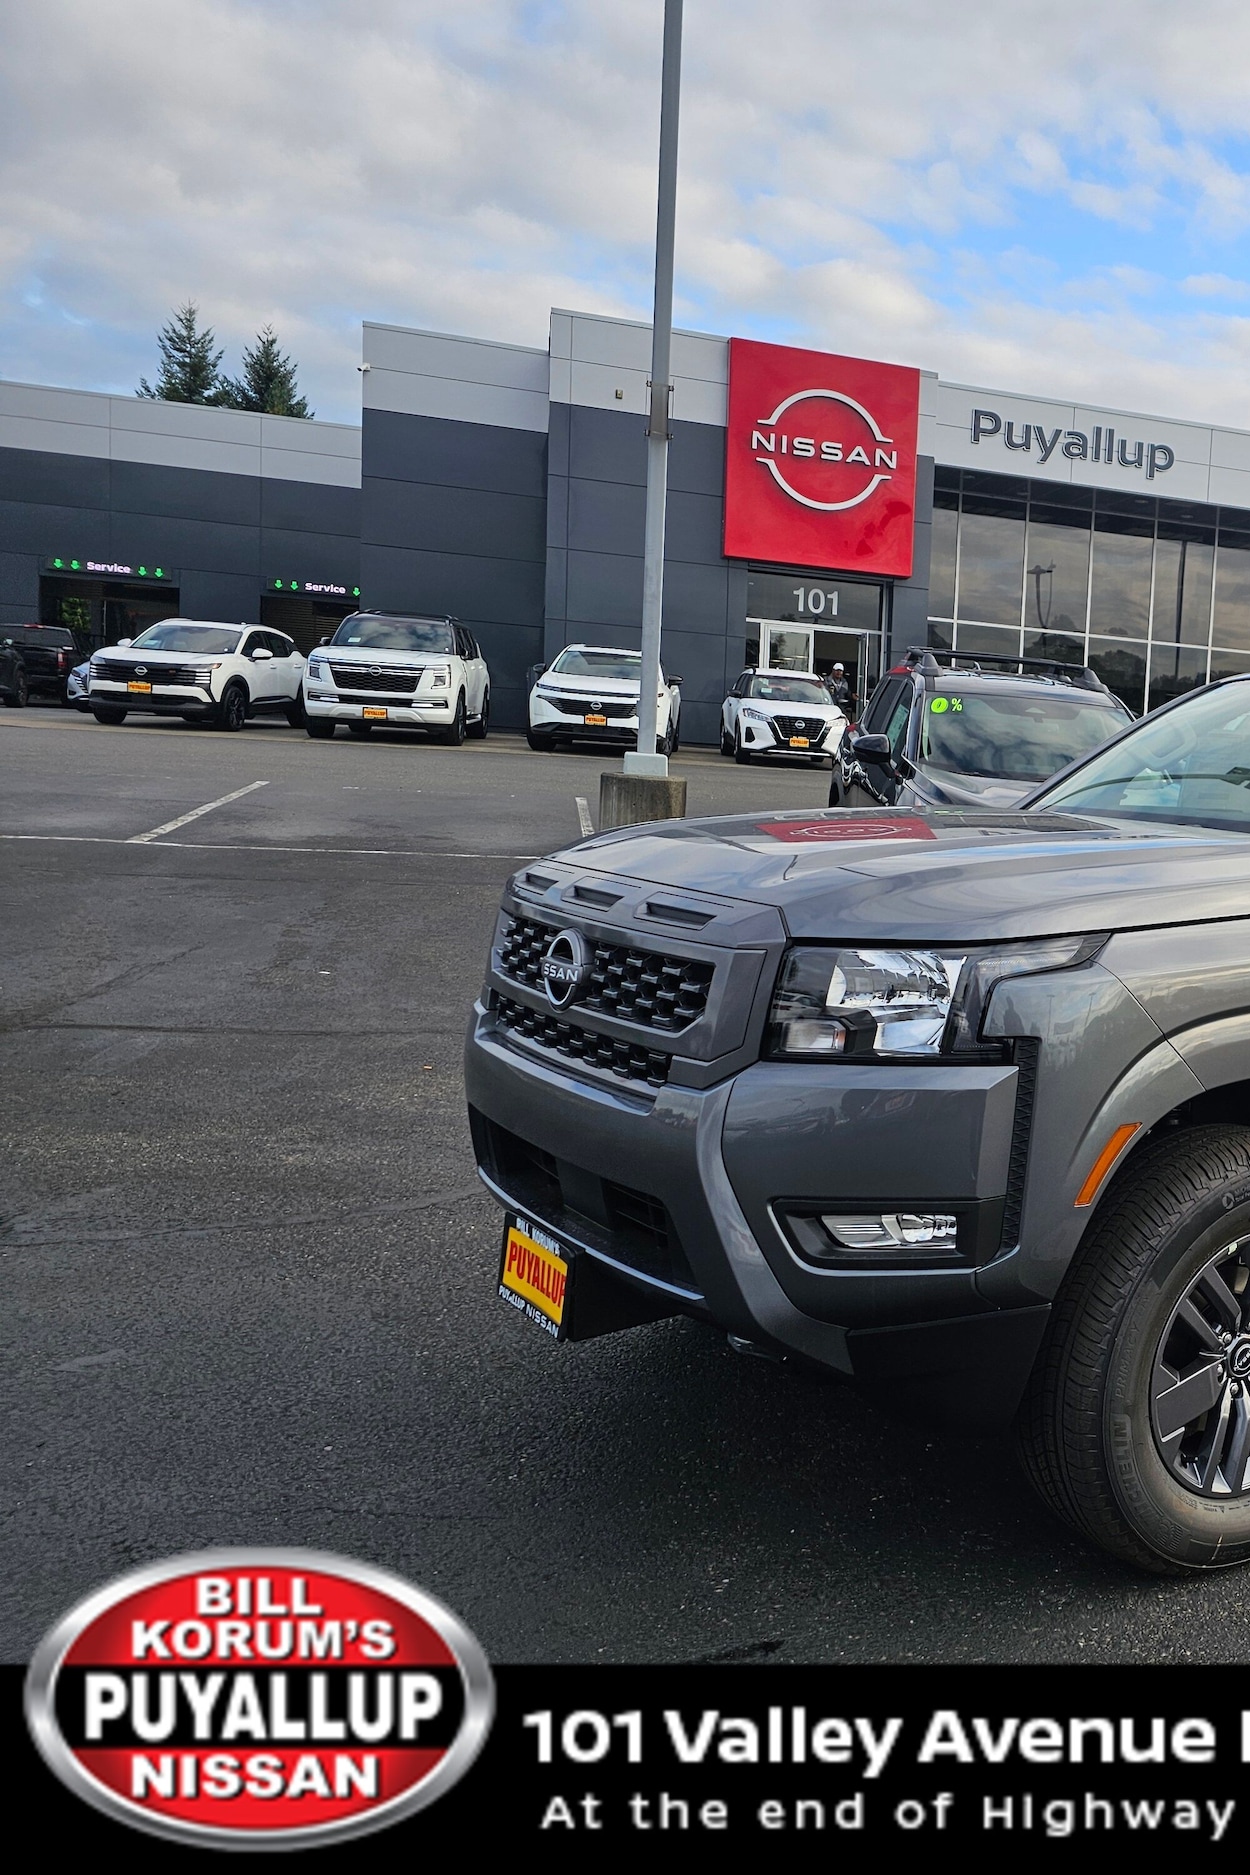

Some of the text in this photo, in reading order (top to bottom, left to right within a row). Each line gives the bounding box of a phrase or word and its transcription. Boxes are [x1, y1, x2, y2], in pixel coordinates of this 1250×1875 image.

[751, 430, 897, 470] NISSAN
[971, 409, 1175, 479] Puyallup
[86, 561, 131, 574] Service
[304, 582, 346, 594] Service
[793, 587, 838, 615] 101
[543, 963, 579, 982] SSAN
[516, 1217, 530, 1237] BILL
[507, 1240, 567, 1308] PUYALLUP
[498, 1285, 559, 1339] PUYALLUP NISSAN
